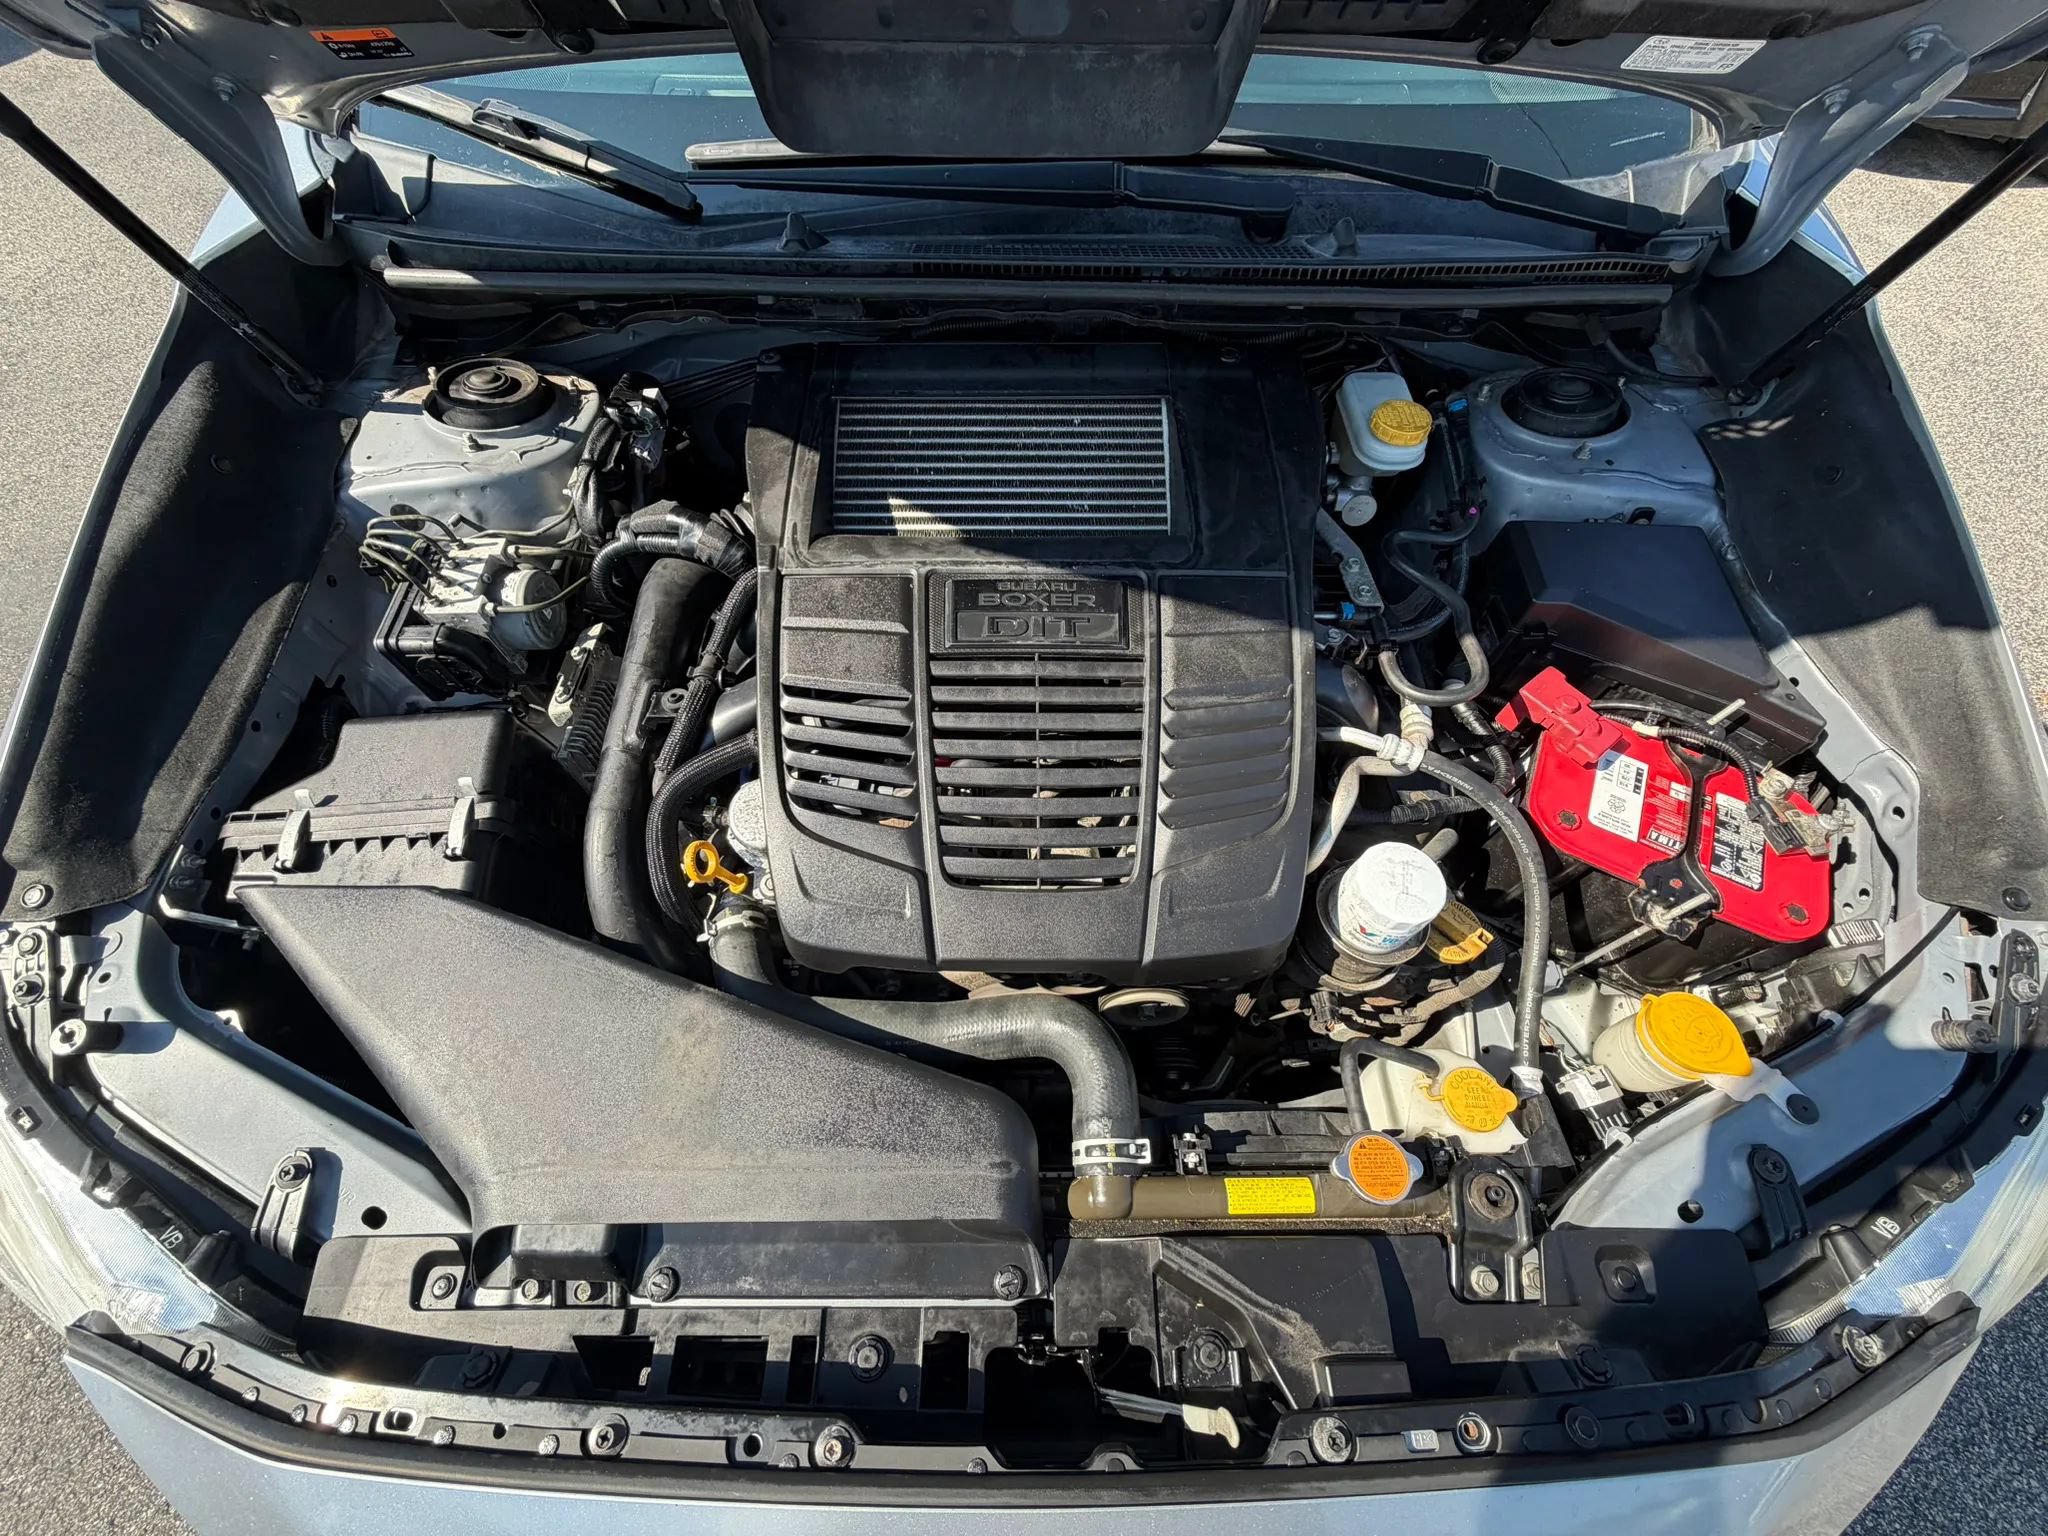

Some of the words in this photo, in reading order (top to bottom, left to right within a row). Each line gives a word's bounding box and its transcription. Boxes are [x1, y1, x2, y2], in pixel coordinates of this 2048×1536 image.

[996, 580, 1077, 592] SUBARU
[977, 592, 1097, 608] BOXER
[982, 614, 1092, 639] DIT
[1649, 830, 1685, 851] TIMA
[159, 1224, 184, 1249] VB
[1870, 1216, 1901, 1239] VB
